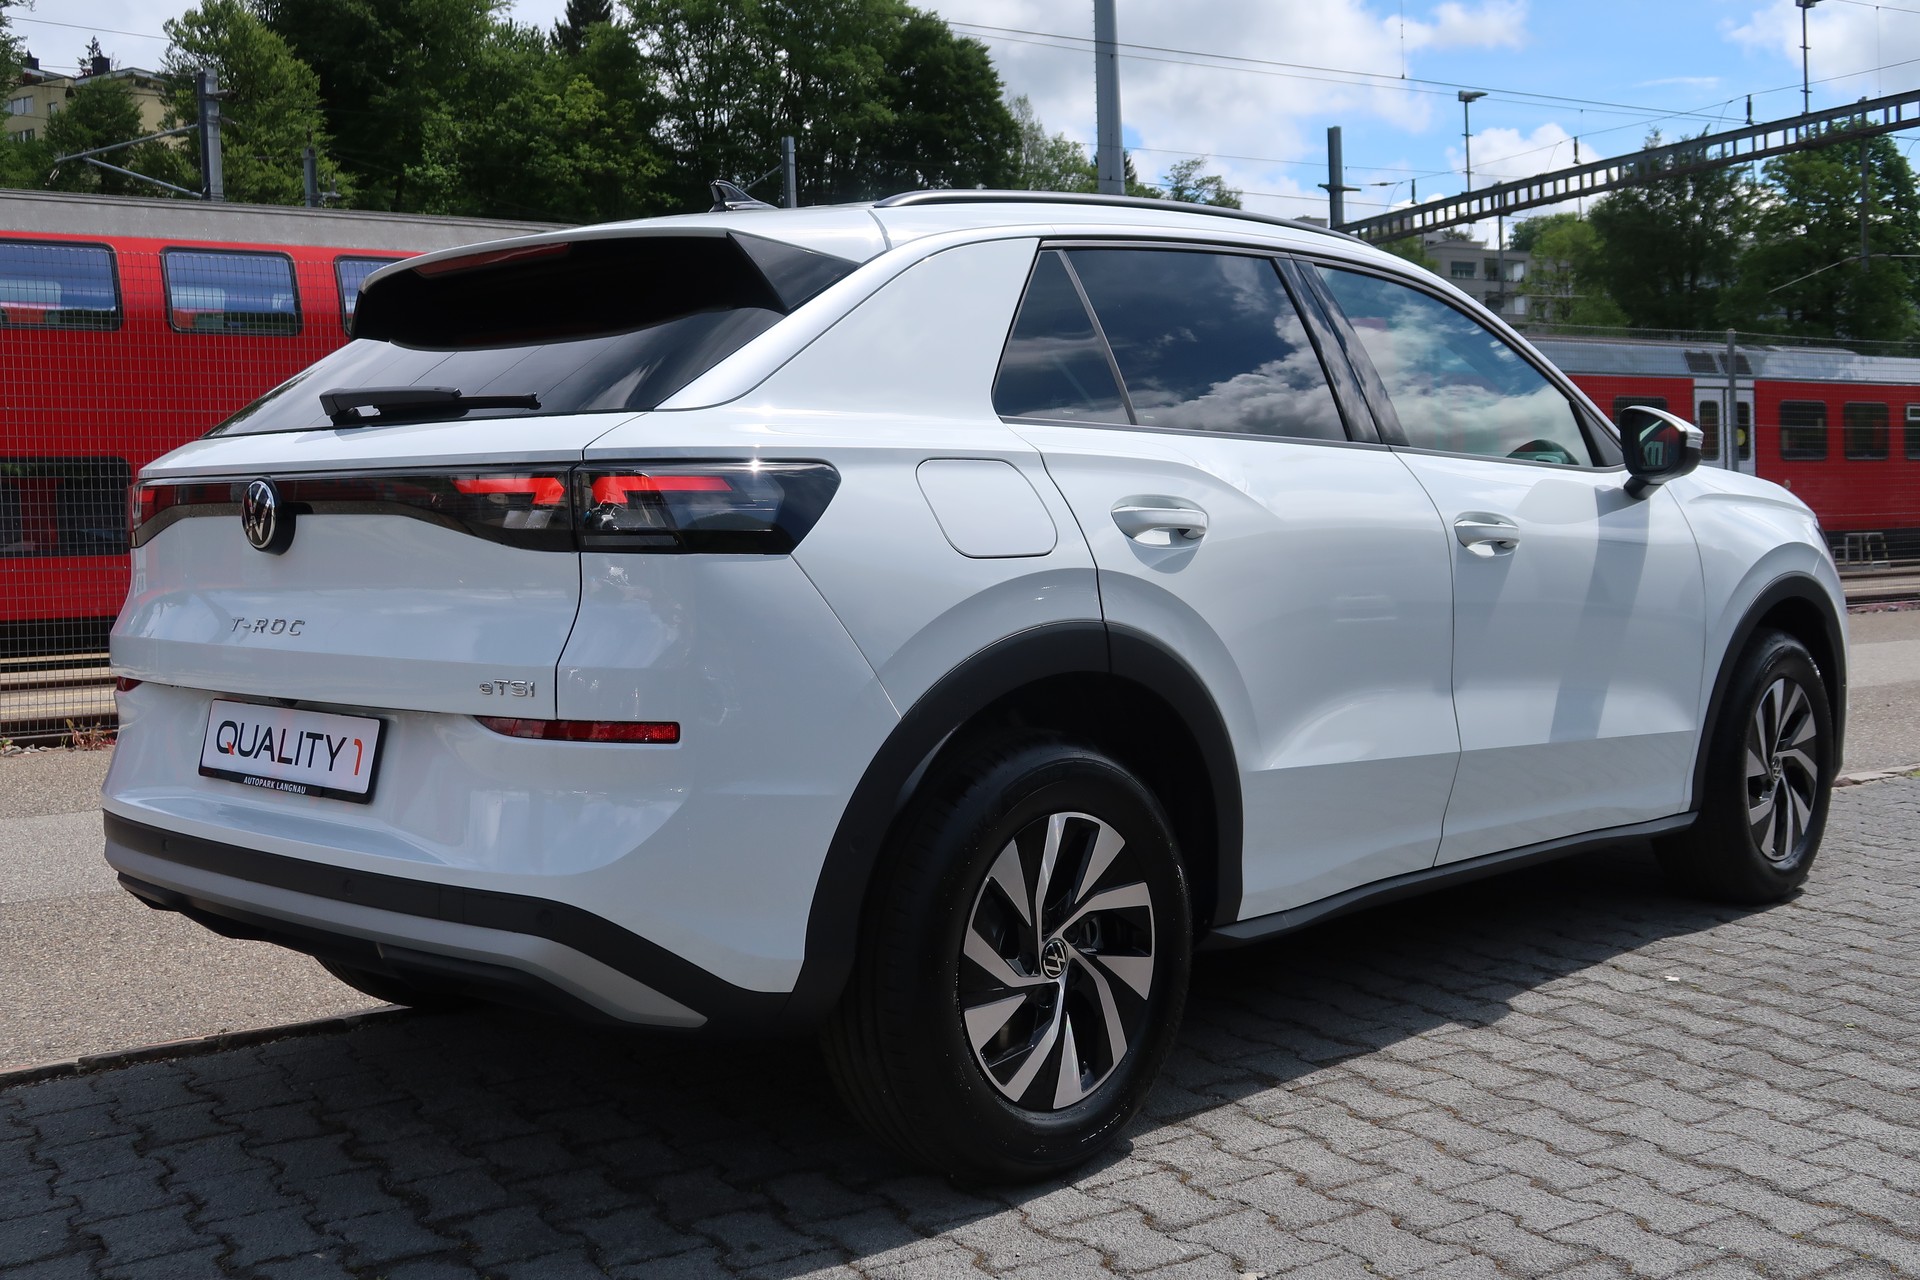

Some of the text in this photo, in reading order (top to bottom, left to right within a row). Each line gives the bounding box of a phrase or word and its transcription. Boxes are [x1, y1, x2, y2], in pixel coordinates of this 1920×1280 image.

[232, 617, 306, 636] T-ROC
[479, 679, 536, 698] eTSI
[216, 720, 347, 771] QUALITY
[243, 776, 307, 794] AUTOPARK LANGNAU
